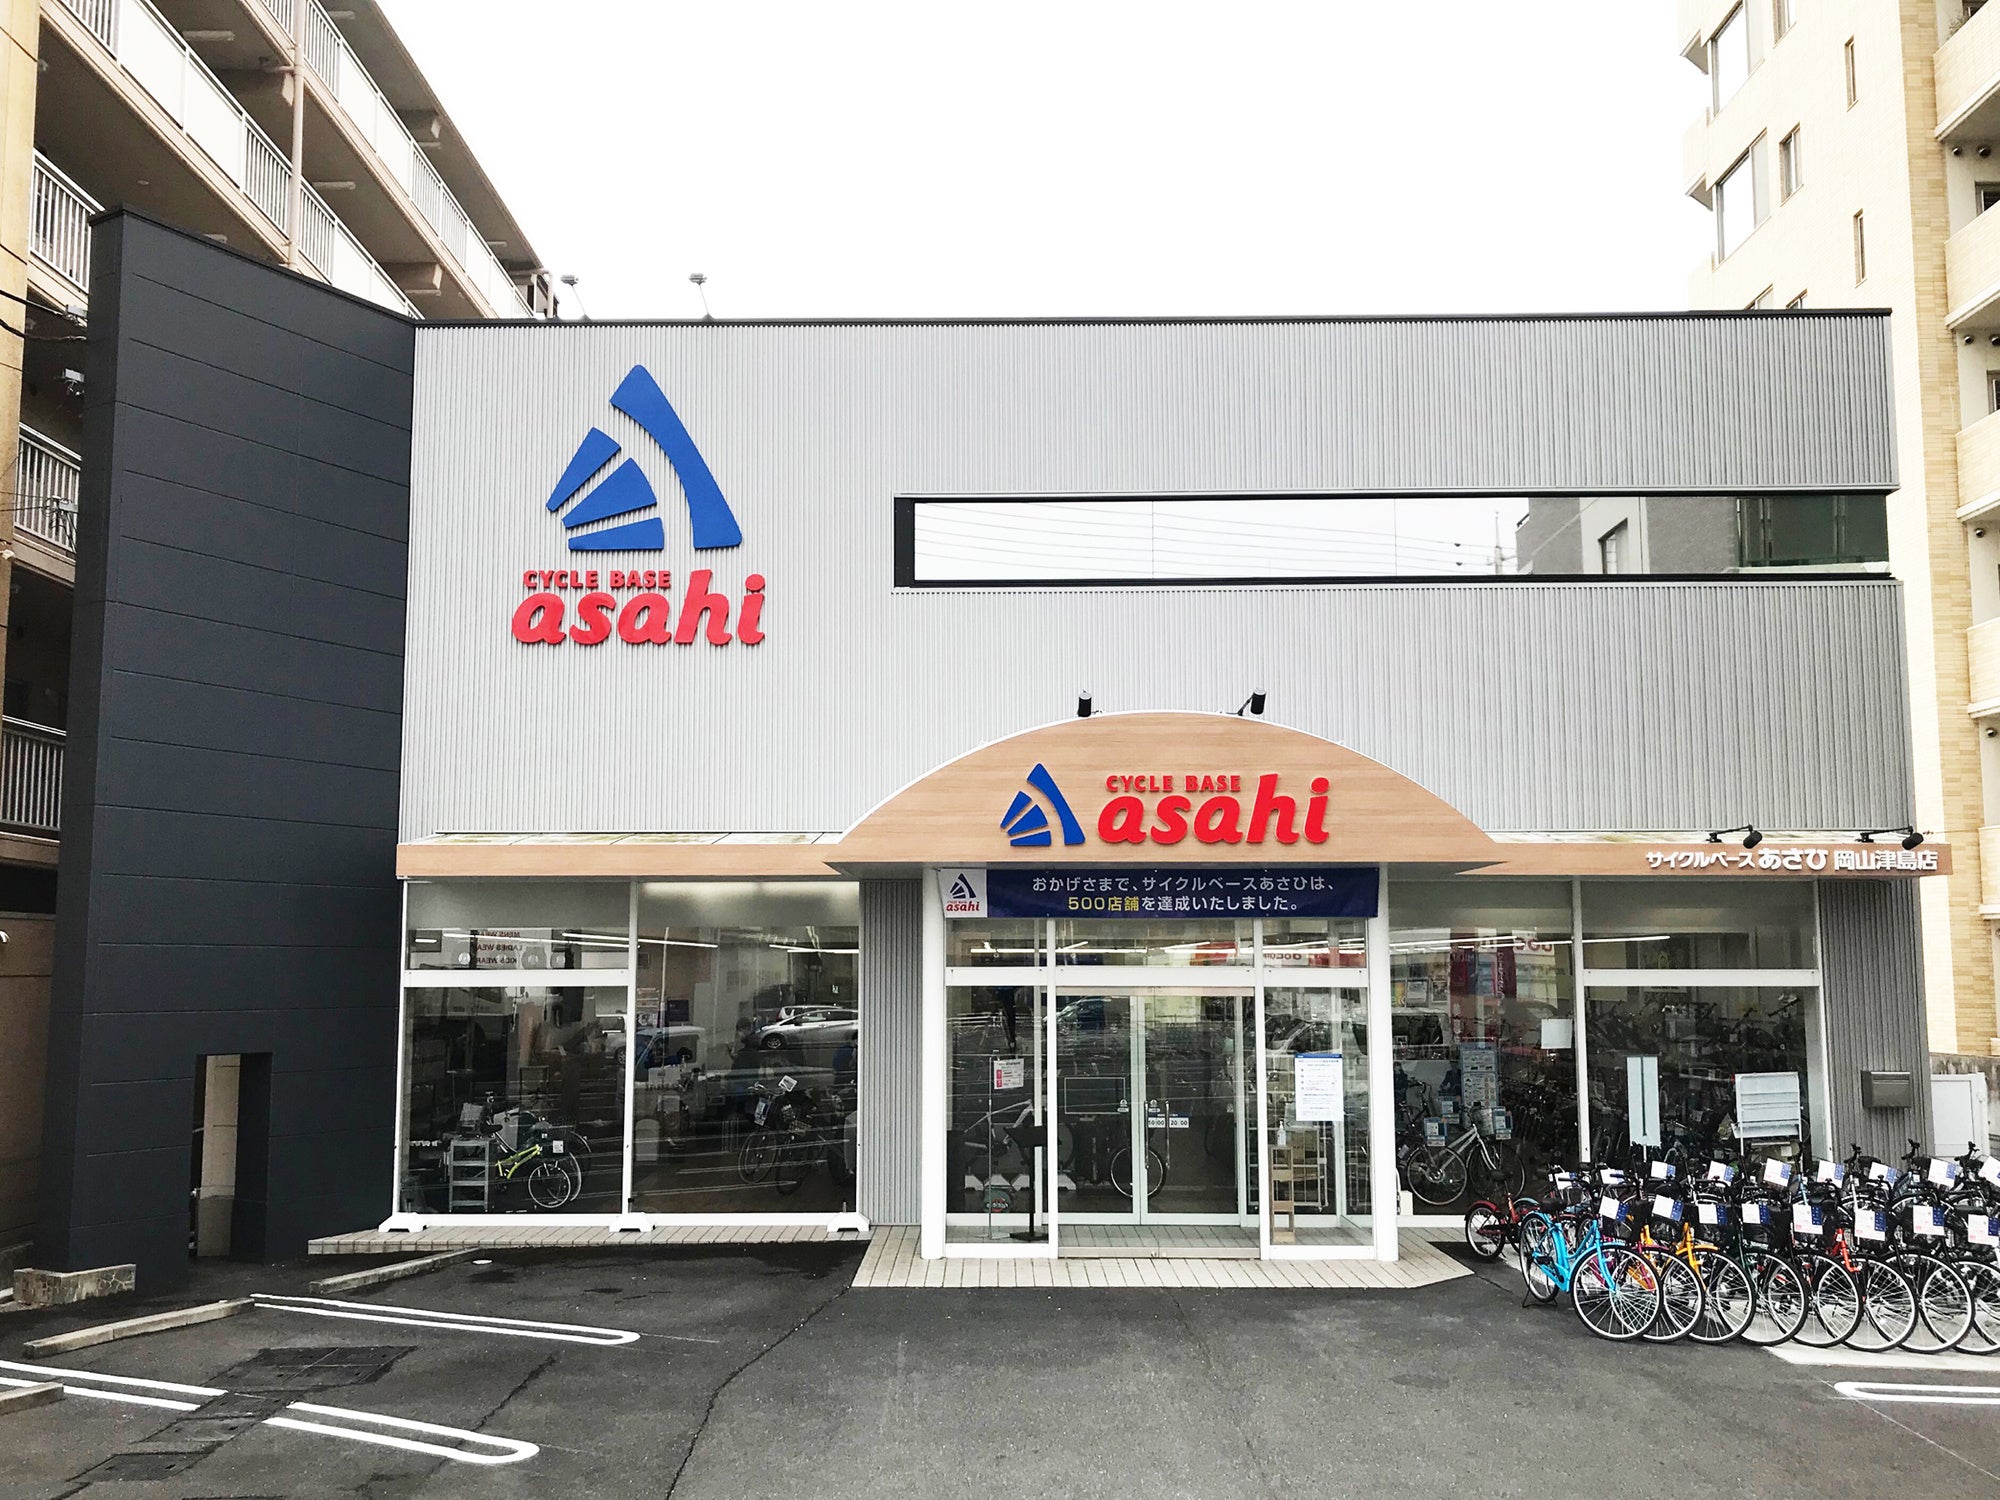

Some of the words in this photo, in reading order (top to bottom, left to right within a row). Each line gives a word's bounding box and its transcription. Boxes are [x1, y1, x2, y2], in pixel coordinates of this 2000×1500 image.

[523, 570, 599, 589] CYCLE
[609, 570, 671, 589] BASE
[512, 569, 766, 645] asahi
[1106, 775, 1174, 792] CYCLE
[1184, 775, 1241, 792] BASE
[1097, 773, 1330, 844] asahi
[1834, 849, 1938, 870] 岡山津島店
[946, 901, 980, 911] asahi
